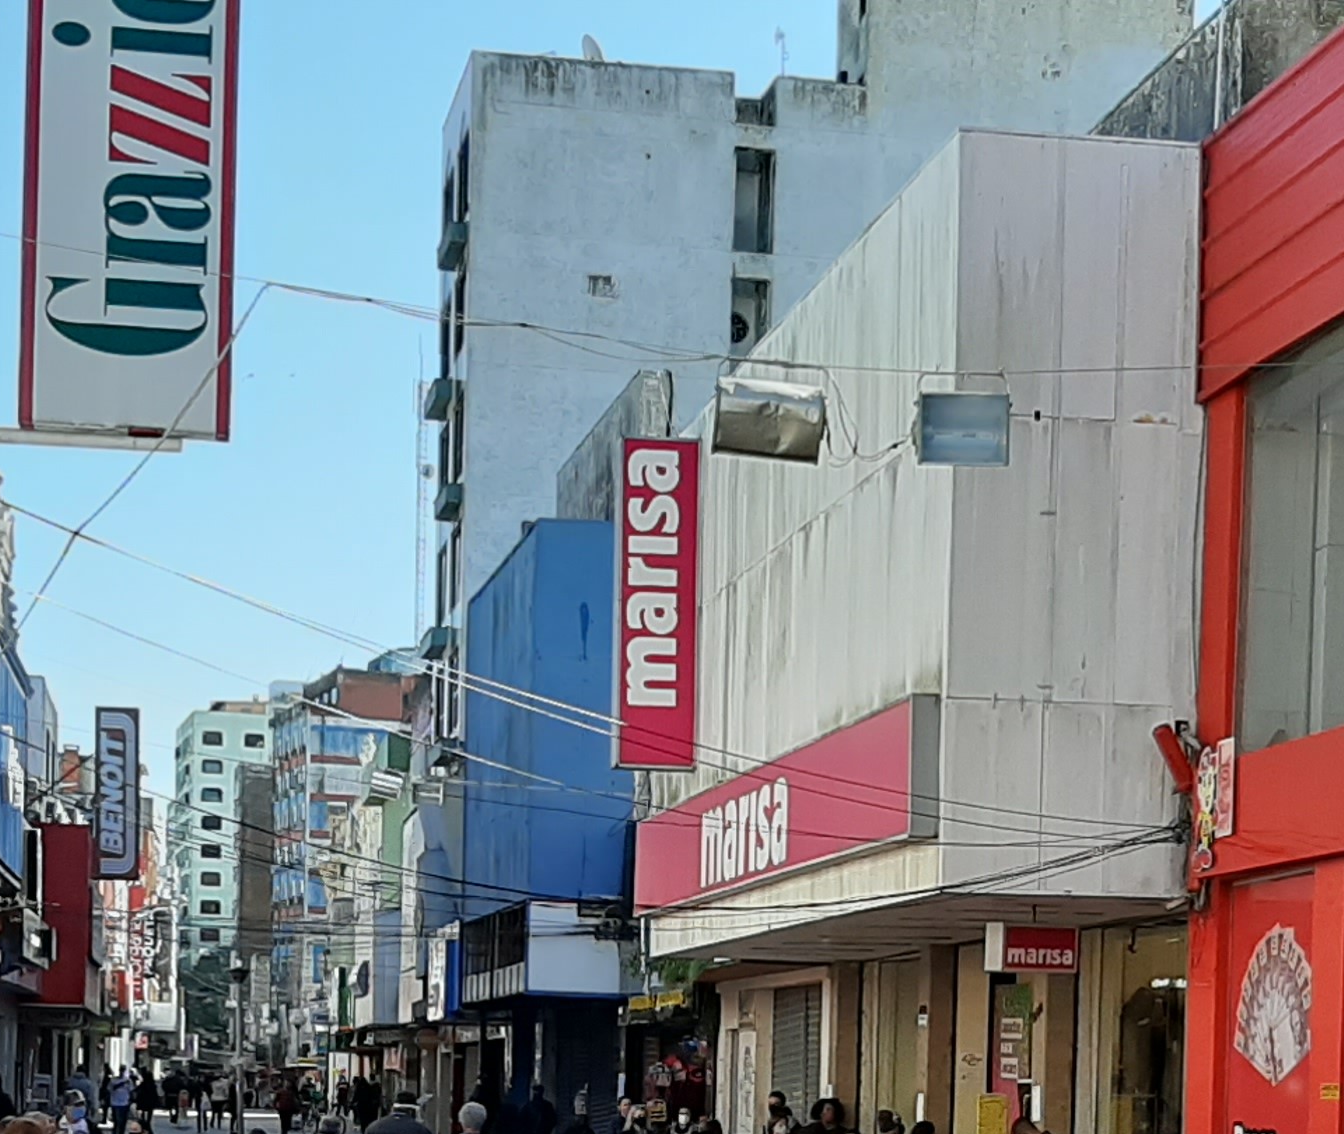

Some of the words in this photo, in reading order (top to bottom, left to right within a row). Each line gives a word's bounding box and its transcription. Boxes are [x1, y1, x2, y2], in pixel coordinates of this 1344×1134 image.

[626, 448, 680, 707] marisa
[700, 776, 788, 888] marisa
[1006, 947, 1074, 966] marisa
